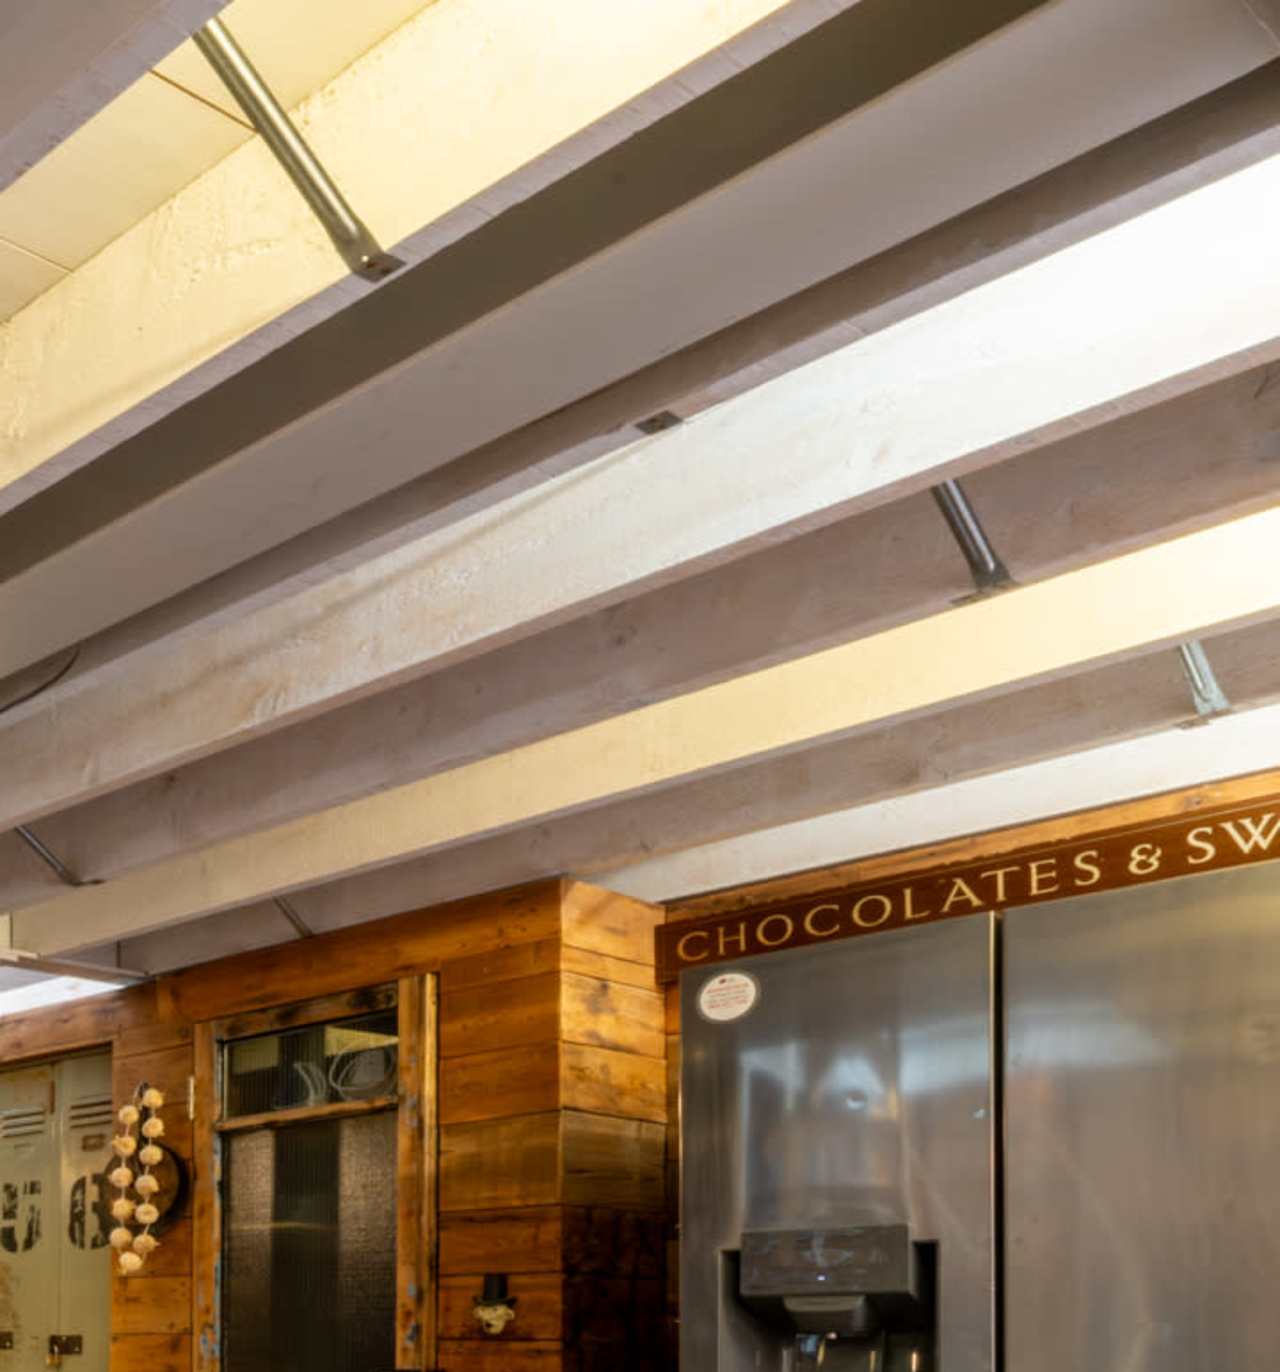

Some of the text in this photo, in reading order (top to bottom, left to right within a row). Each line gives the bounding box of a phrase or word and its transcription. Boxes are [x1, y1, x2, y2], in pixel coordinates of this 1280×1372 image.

[676, 811, 1280, 962] CHOCOLATES & SW
[0, 1180, 42, 1253] 5
